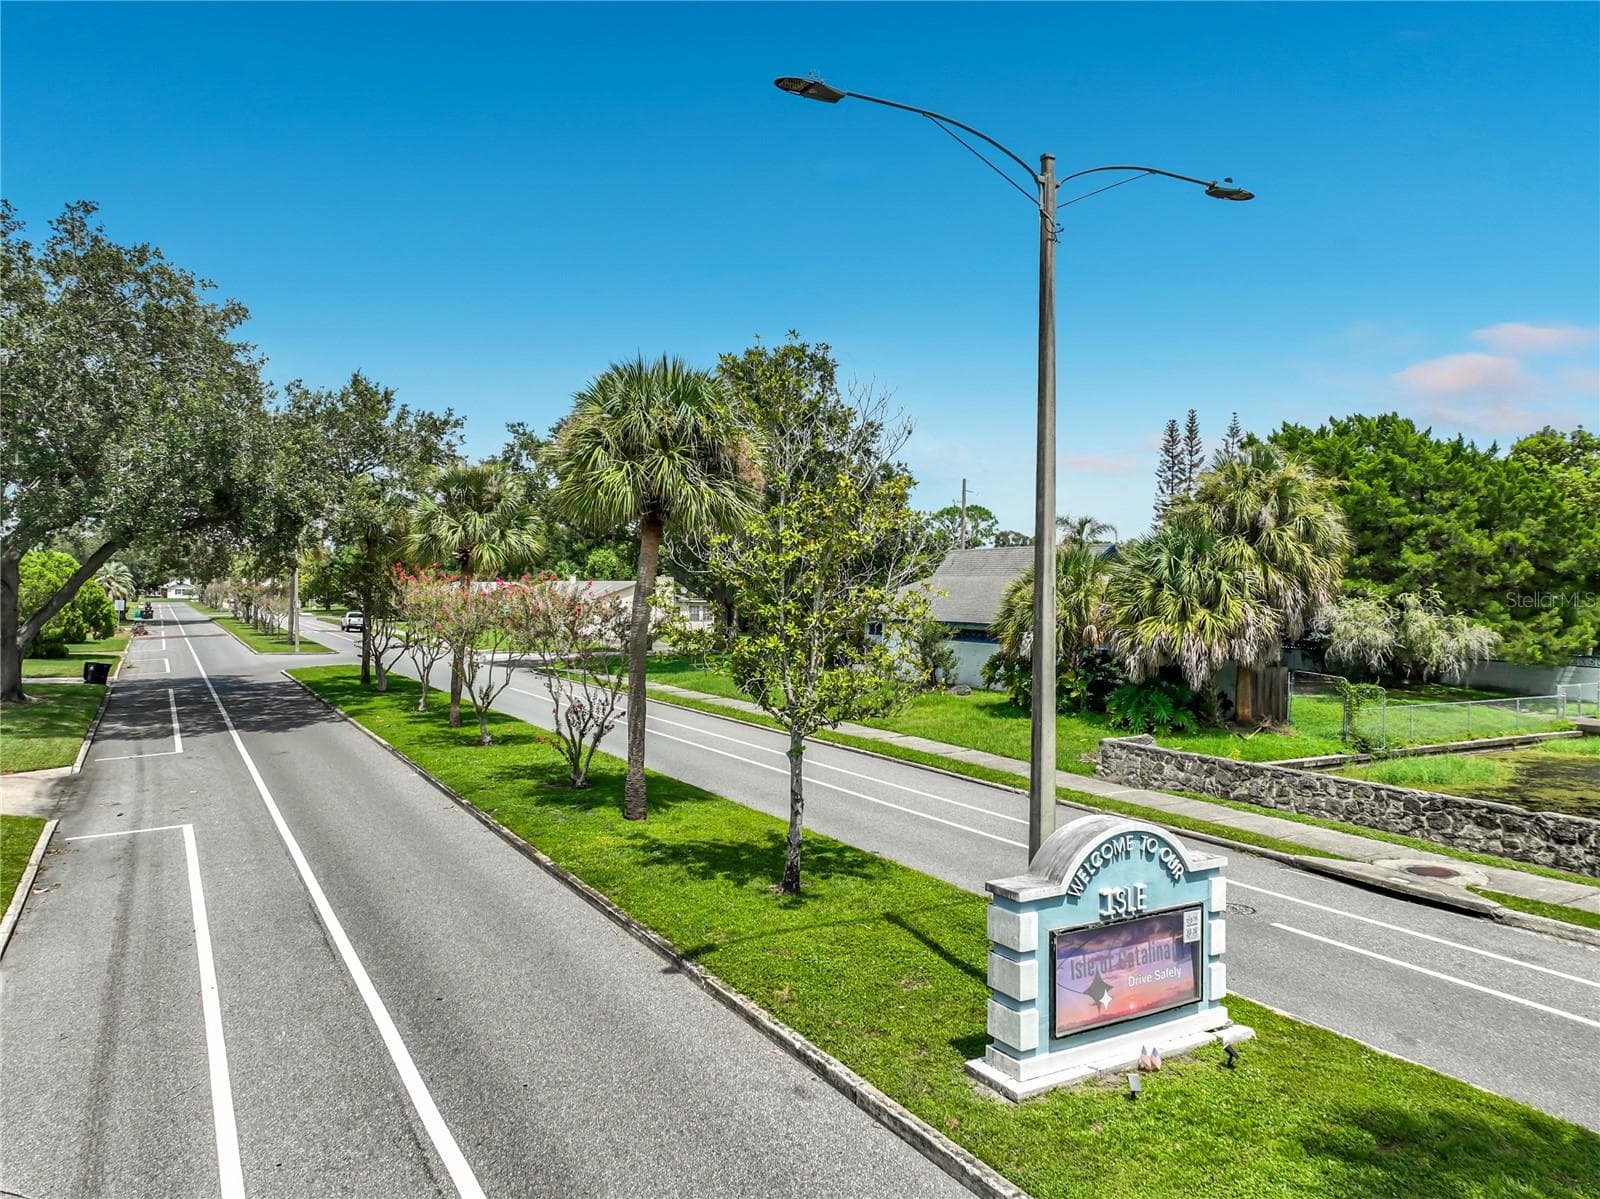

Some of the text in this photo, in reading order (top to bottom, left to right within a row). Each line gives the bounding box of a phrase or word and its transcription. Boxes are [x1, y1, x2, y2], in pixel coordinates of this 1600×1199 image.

[1068, 835, 1185, 897] WELCOME TO OUR
[1100, 882, 1148, 917] ISLE
[1070, 955, 1098, 980] Isle
[1101, 954, 1113, 974] of
[1128, 966, 1182, 987] Drive Safely
